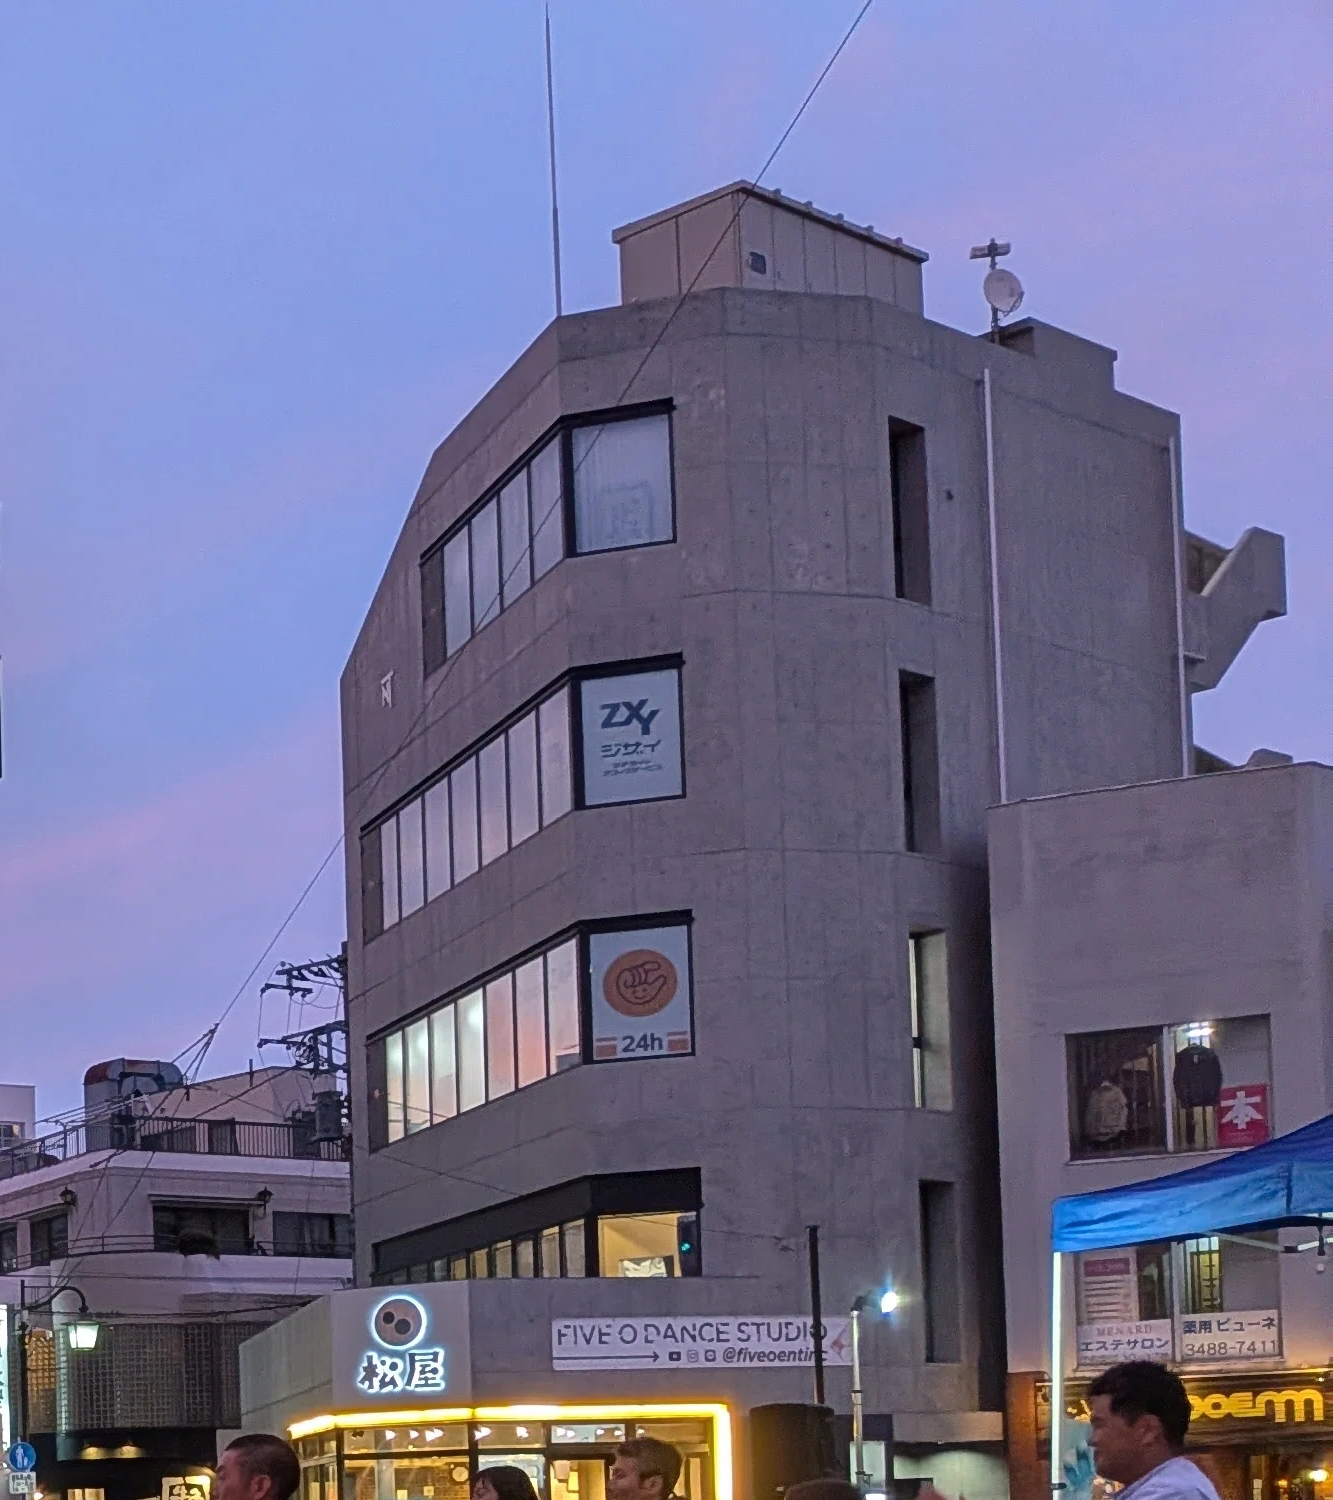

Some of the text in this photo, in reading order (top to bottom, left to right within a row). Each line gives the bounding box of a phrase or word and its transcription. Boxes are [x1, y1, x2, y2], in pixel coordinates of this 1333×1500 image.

[600, 698, 661, 736] ZXY
[600, 739, 662, 758] ジザイ
[621, 1032, 664, 1054] 24h
[1221, 1090, 1263, 1129] 本
[557, 1324, 613, 1346] FIVE
[643, 1321, 731, 1344] DANCE
[1079, 1338, 1170, 1352] エステサロン
[1184, 1339, 1278, 1357] 3488-7411
[357, 1348, 446, 1393] 松屋
